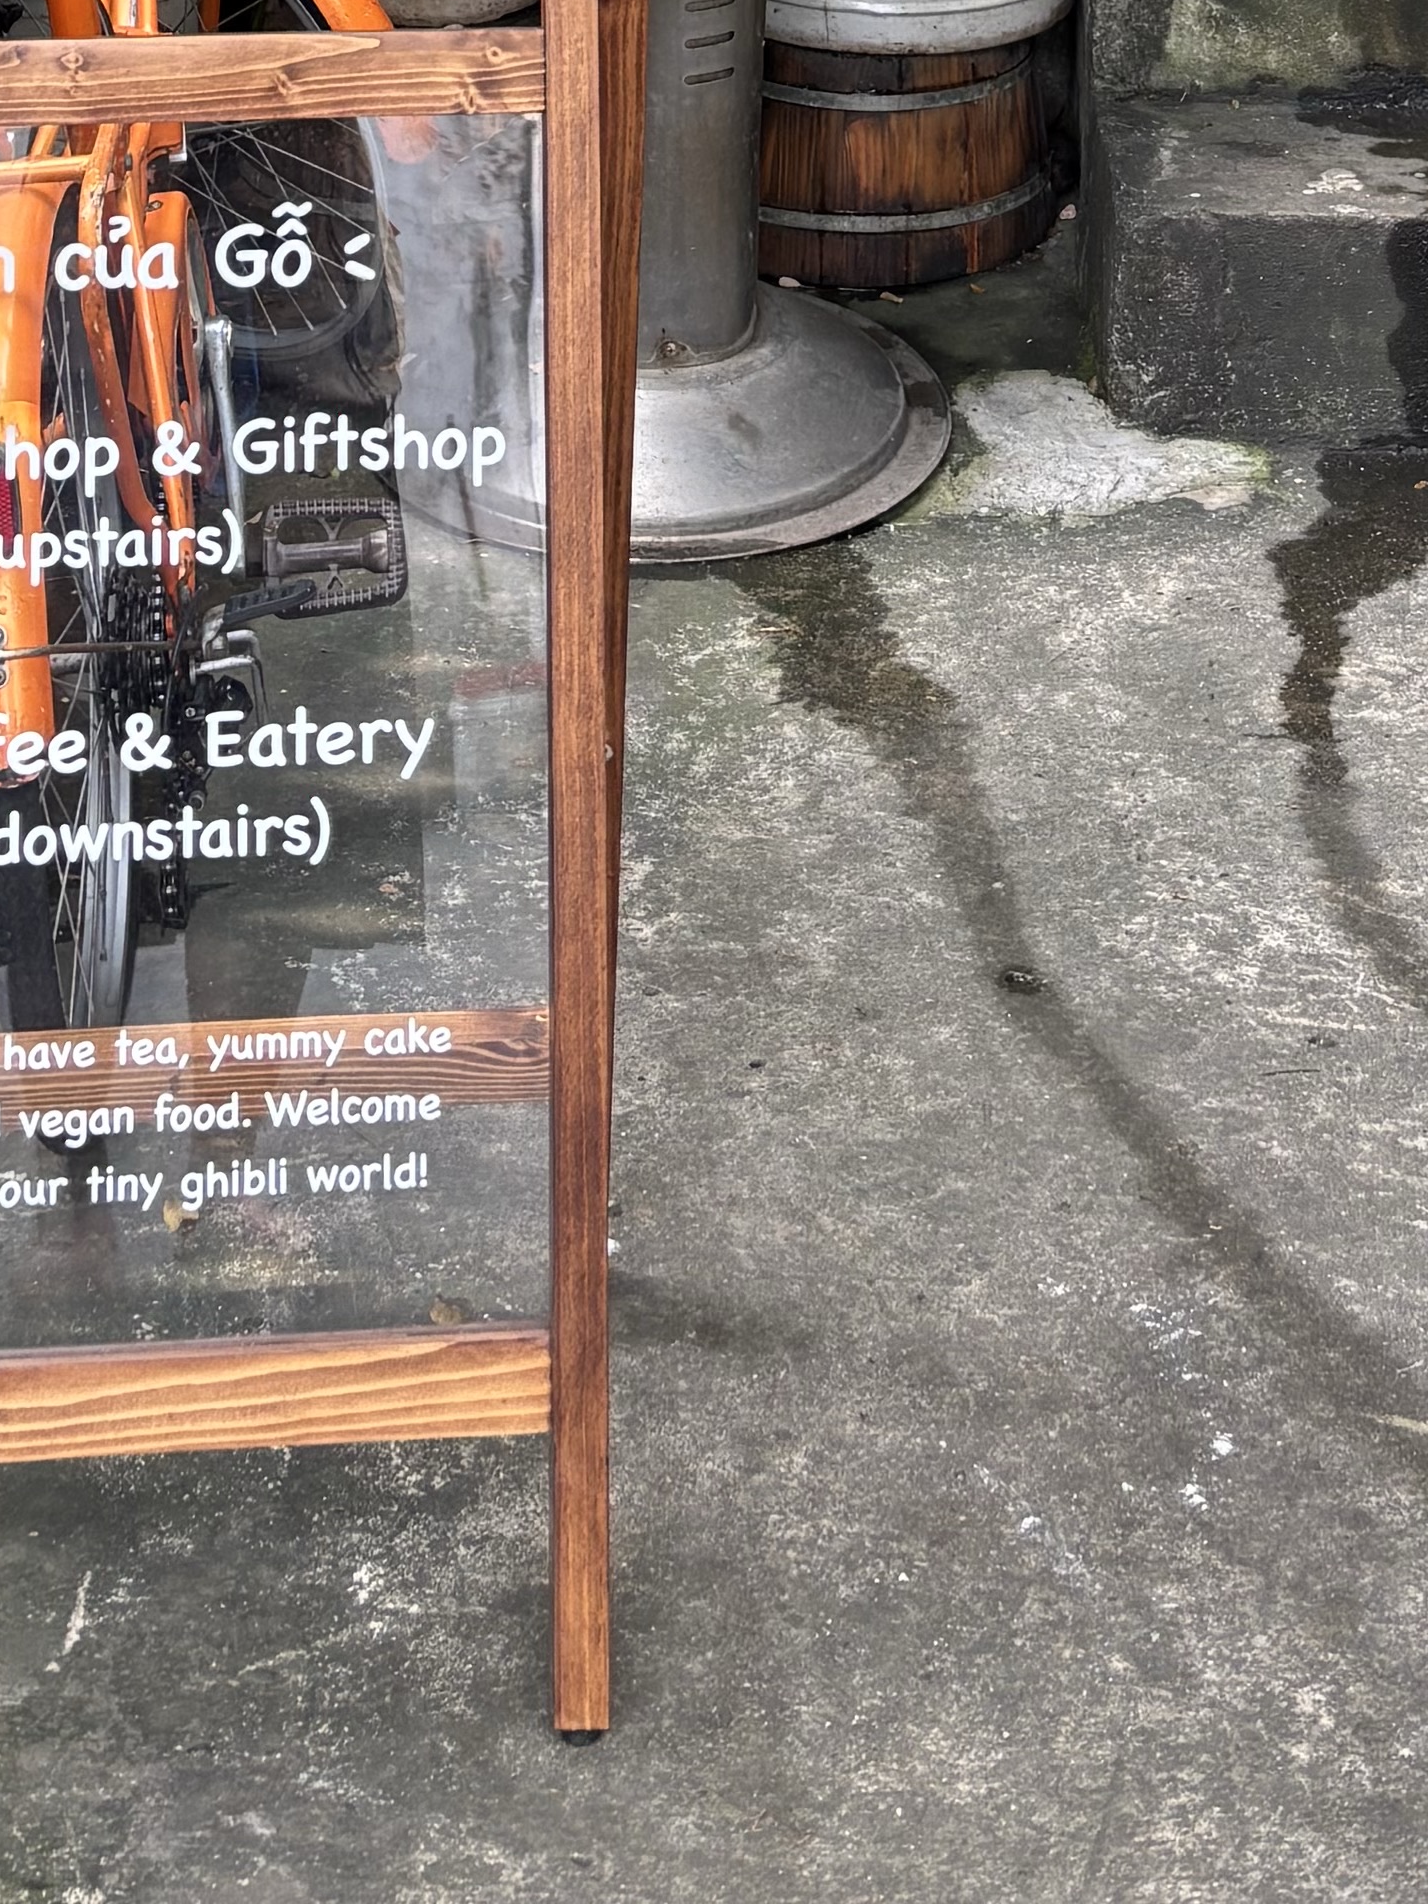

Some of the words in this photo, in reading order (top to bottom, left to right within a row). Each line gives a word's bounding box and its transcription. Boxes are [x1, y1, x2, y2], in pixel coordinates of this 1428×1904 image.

[53, 214, 180, 292] của
[214, 200, 313, 289] Gỗ
[151, 419, 203, 478] &
[231, 411, 507, 488] Giftshop
[119, 711, 173, 773] &
[204, 705, 436, 781] Eatery
[2, 1032, 97, 1072] have
[113, 1028, 191, 1071] tea,
[205, 1028, 348, 1073] yummy
[362, 1016, 453, 1057] cake
[17, 1105, 136, 1150] vegan
[152, 1090, 252, 1133] food.
[263, 1086, 443, 1129] Welcome
[85, 1163, 165, 1213] tiny
[179, 1157, 288, 1213] ghibli
[305, 1150, 429, 1194] world!
